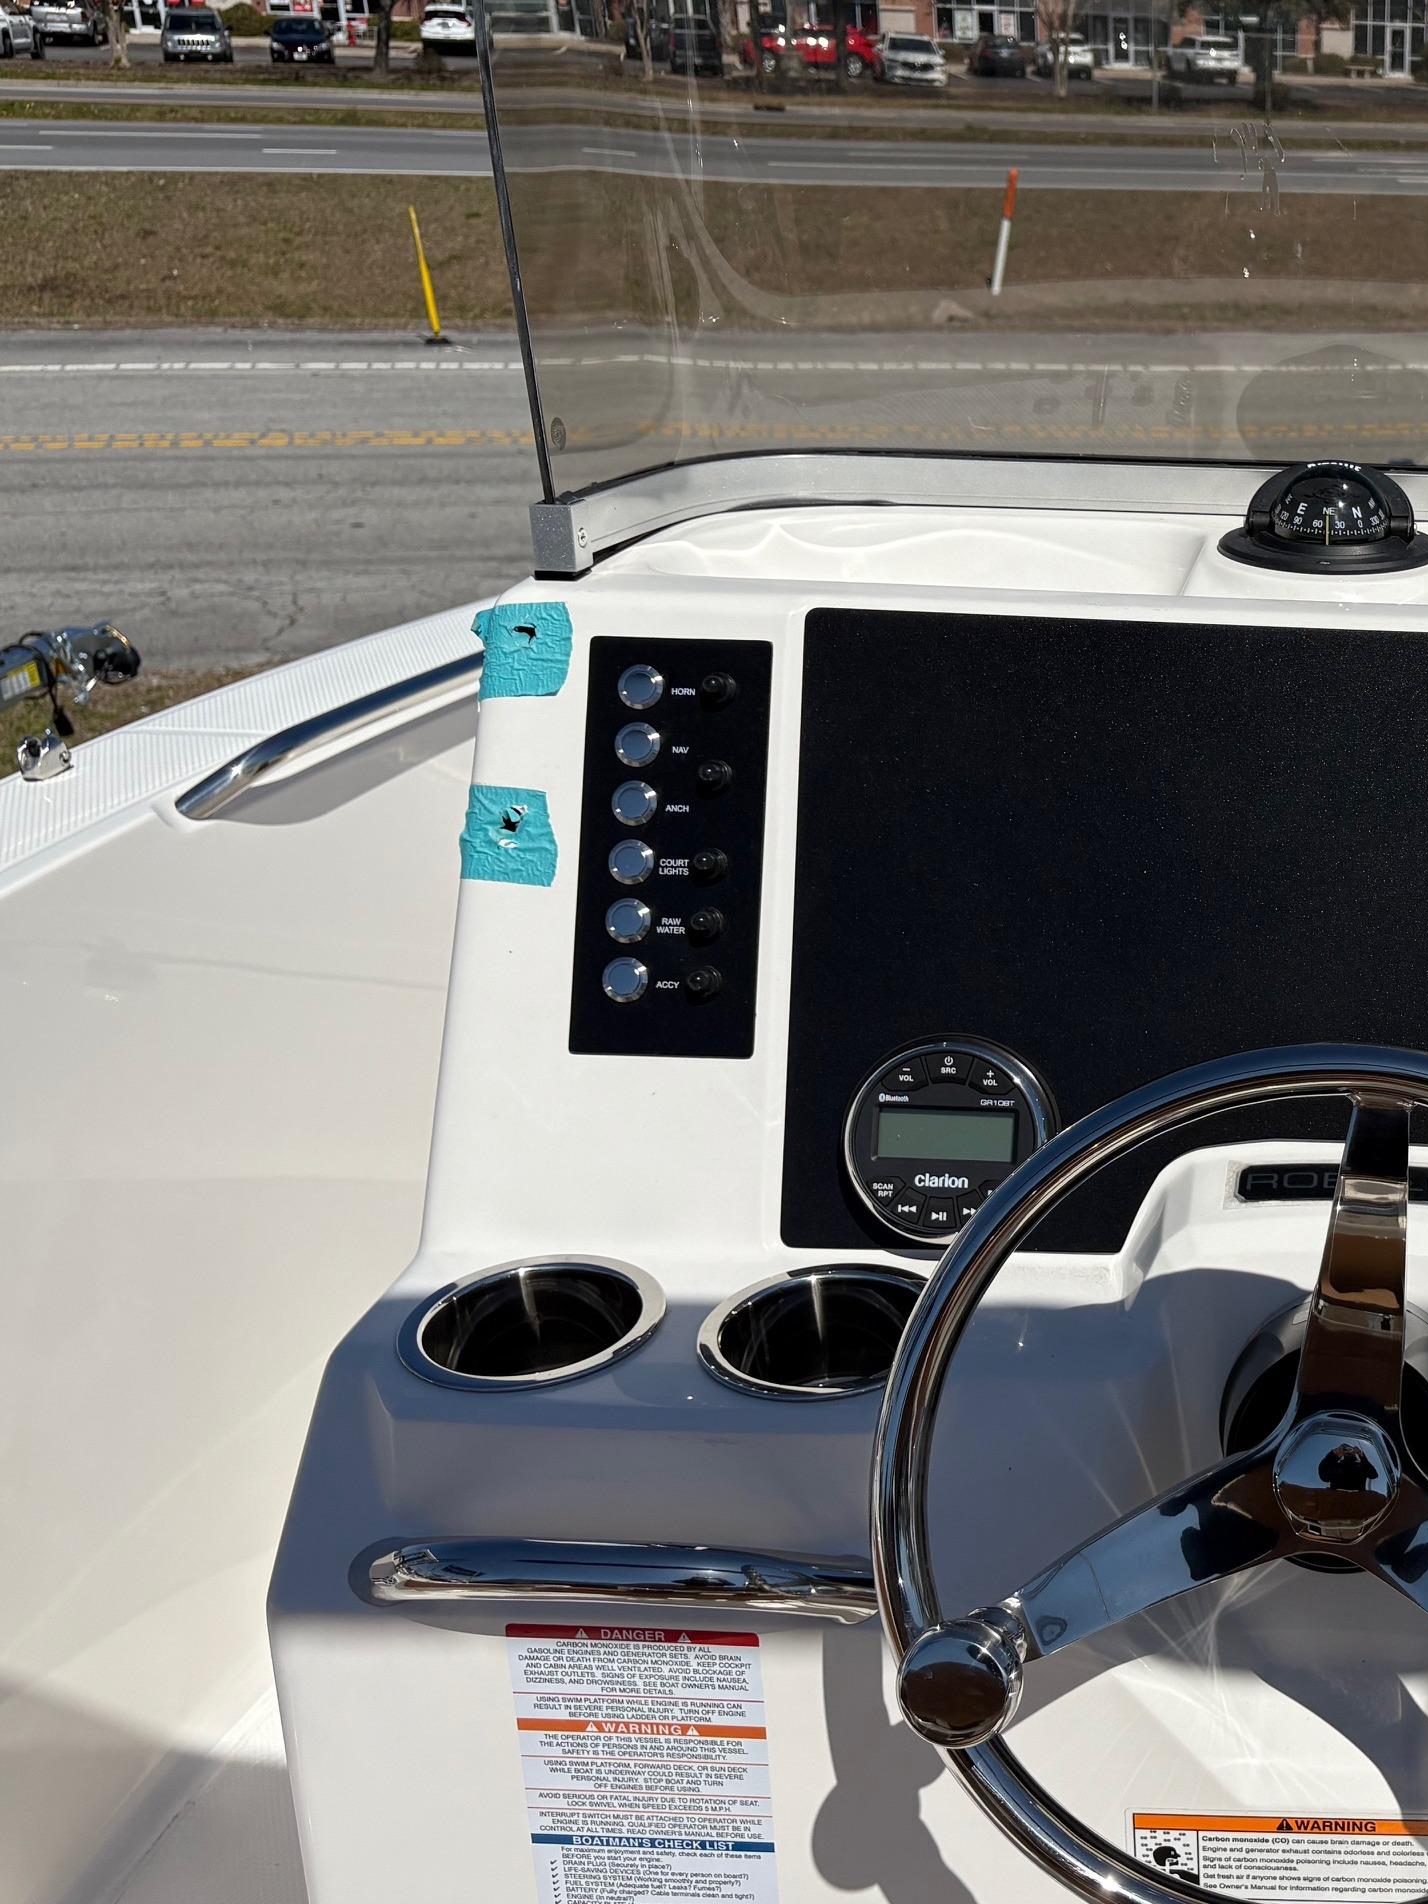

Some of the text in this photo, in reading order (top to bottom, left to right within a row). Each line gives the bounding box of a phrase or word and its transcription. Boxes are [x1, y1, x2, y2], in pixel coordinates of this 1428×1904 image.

[1297, 503, 1307, 514] E
[1322, 507, 1336, 515] NE
[1352, 507, 1362, 518] N
[1293, 516, 1302, 524] 90
[1358, 520, 1363, 528] 0
[671, 688, 696, 696] HORN
[672, 746, 689, 754] NAV
[660, 858, 690, 867] COURT
[659, 867, 689, 876] LIGHTS
[661, 917, 681, 925] RAW
[656, 926, 685, 934] WATER
[656, 981, 680, 989] ACCY
[601, 1629, 665, 1642] DANGER
[555, 1640, 588, 1648] CARBON
[641, 1643, 684, 1651] PRODUCED
[602, 1722, 682, 1735] WARNING
[1294, 1819, 1376, 1832] WARNING
[572, 1836, 735, 1850] BOATMAN'S CHECK LIST
